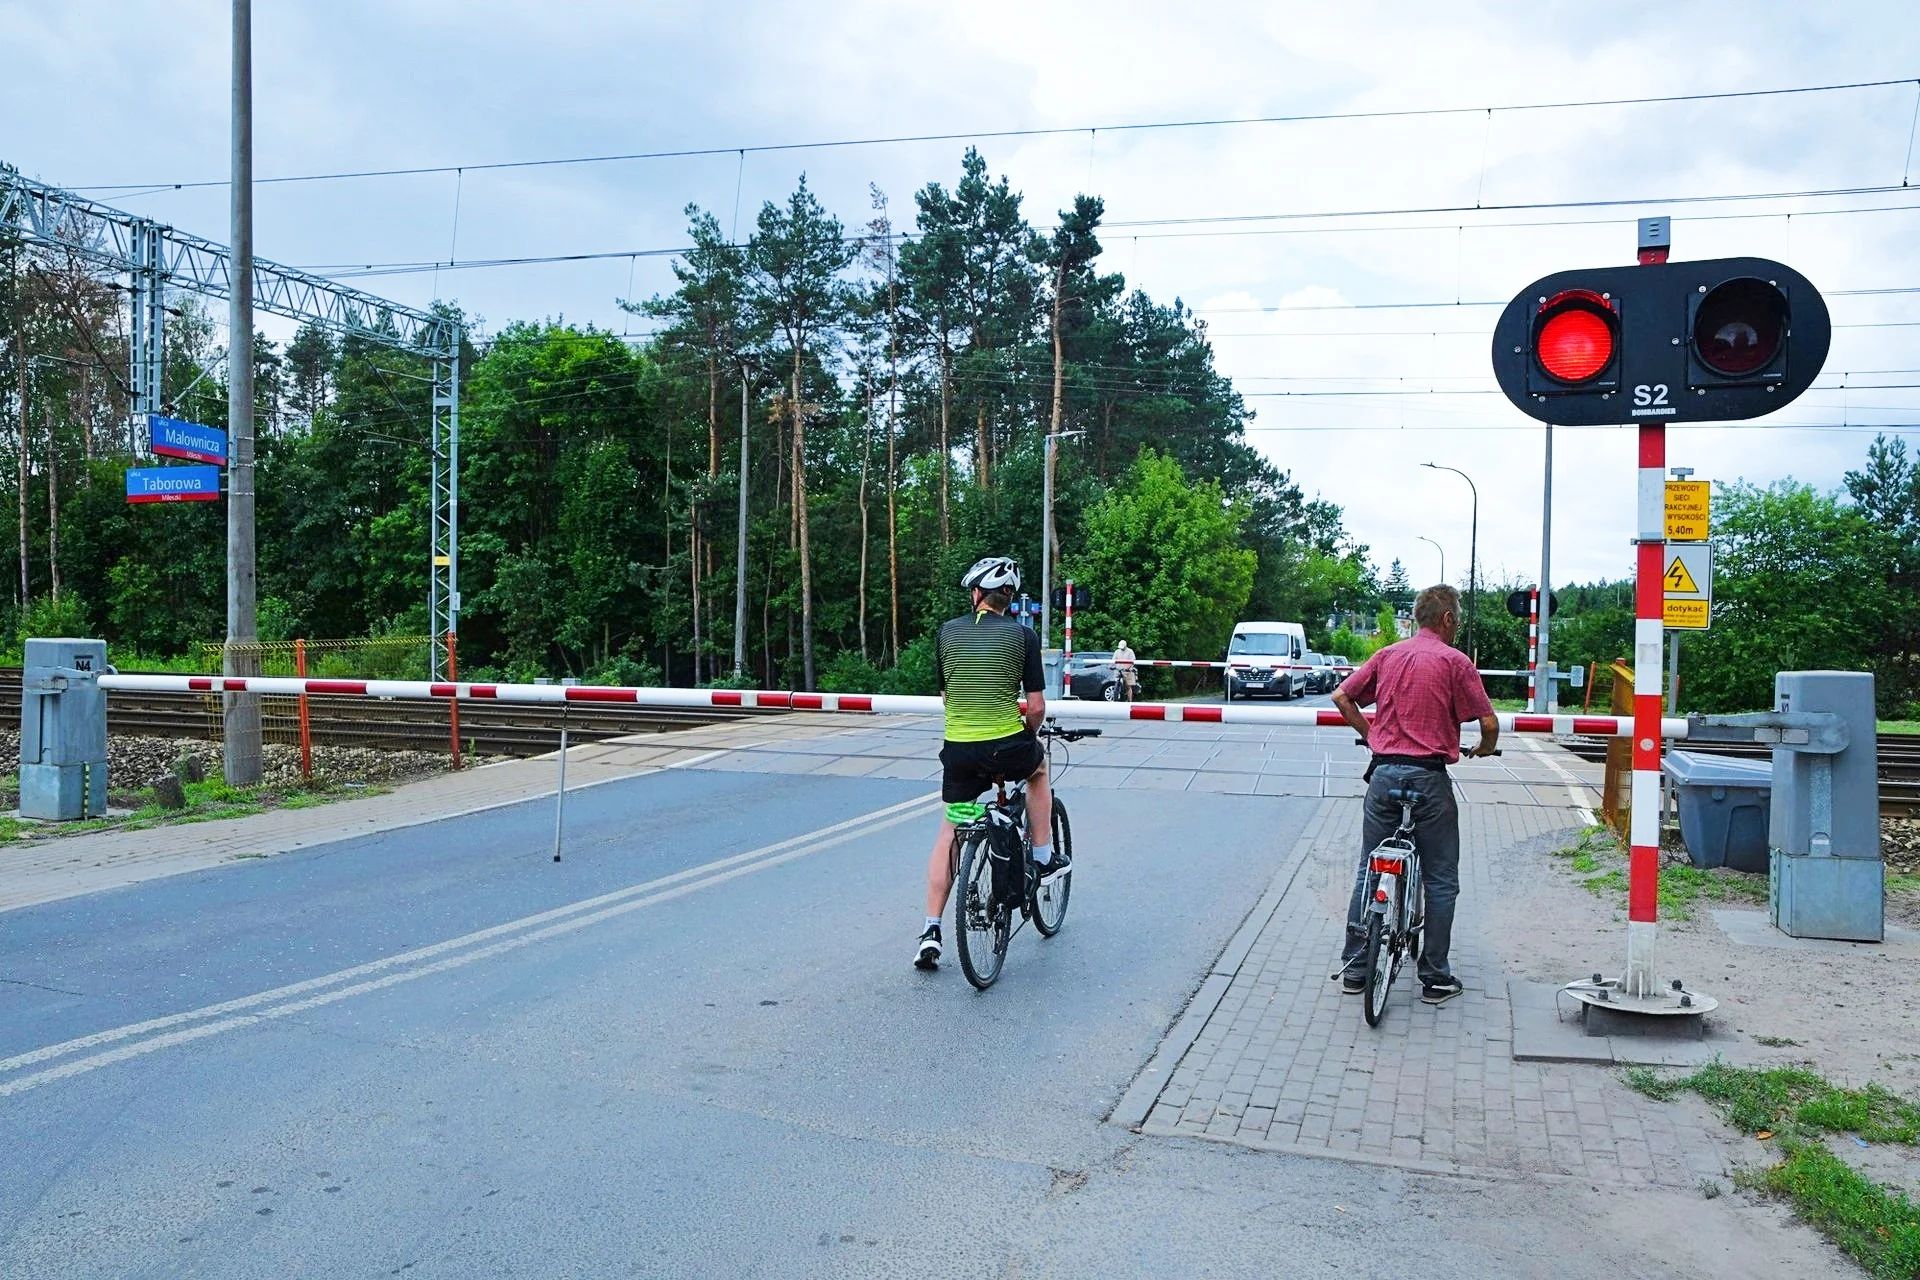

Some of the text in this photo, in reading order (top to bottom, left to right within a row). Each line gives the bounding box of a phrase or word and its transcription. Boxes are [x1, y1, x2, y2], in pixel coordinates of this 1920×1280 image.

[1633, 384, 1669, 406] S2
[165, 429, 220, 452] Malownicza
[142, 477, 201, 491] Taborowa
[76, 660, 91, 671] N4
